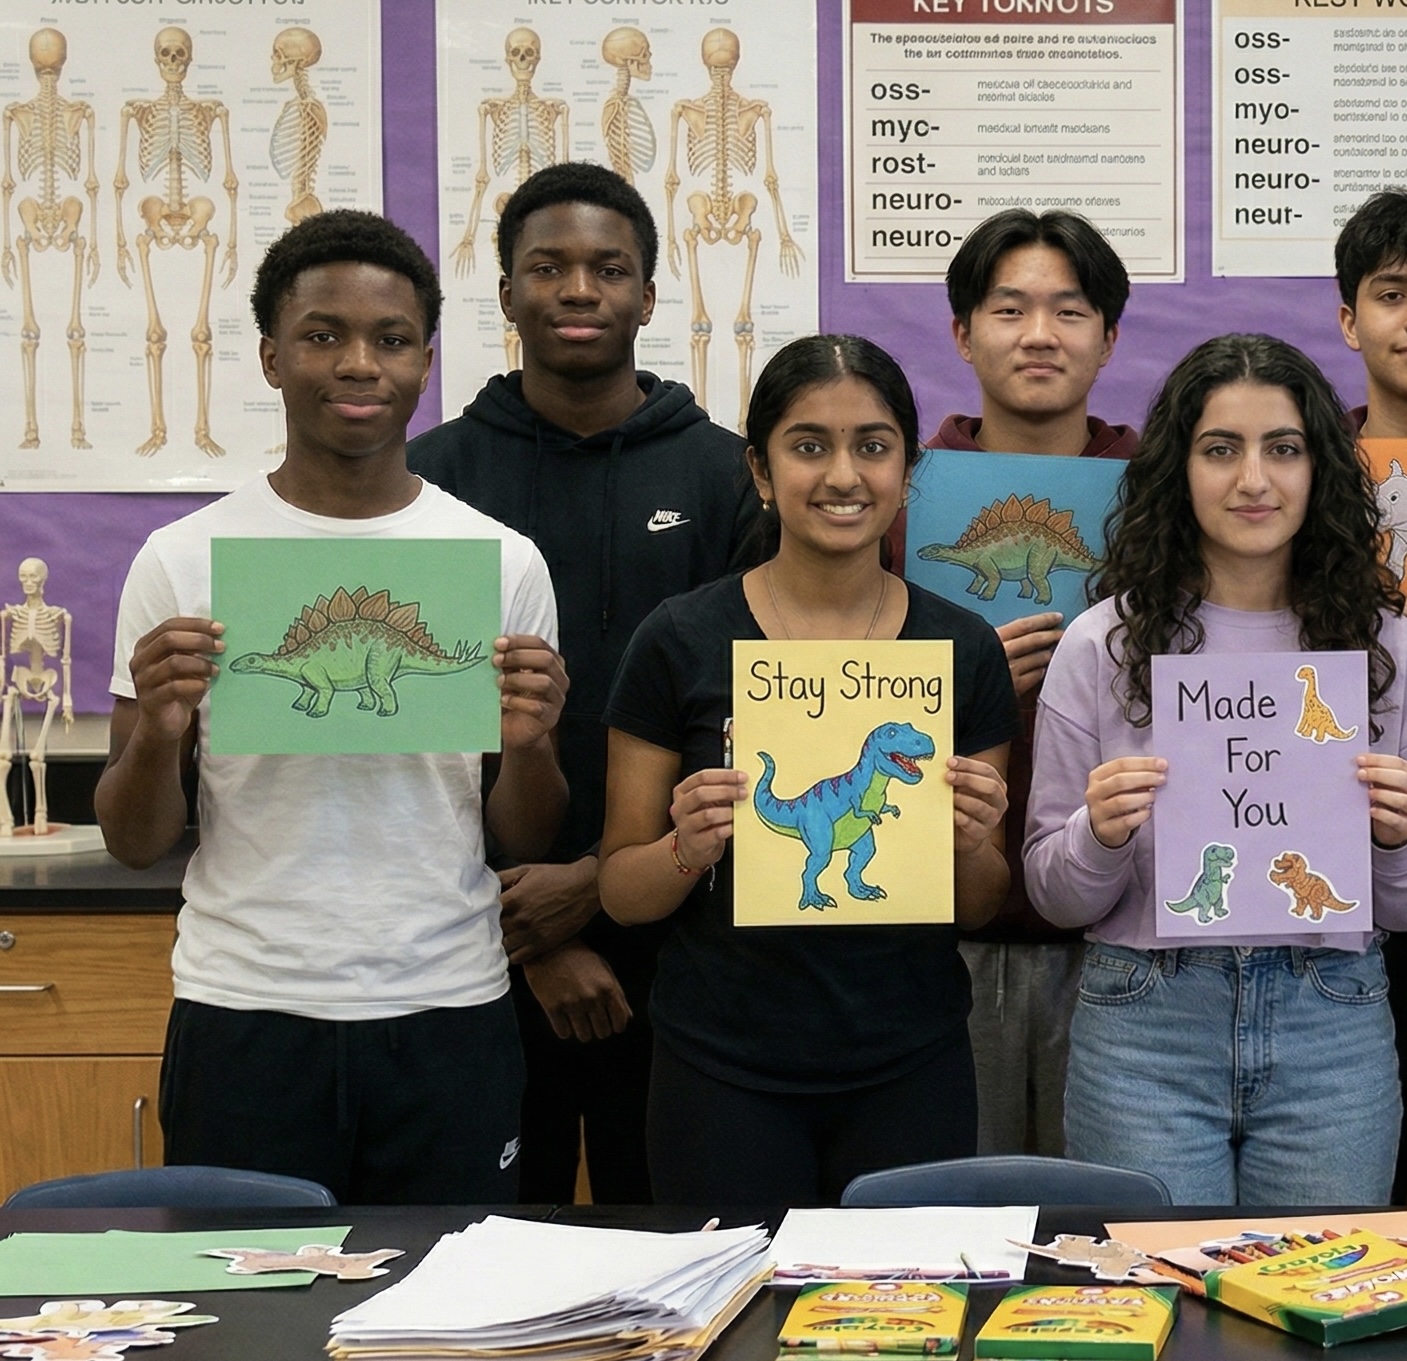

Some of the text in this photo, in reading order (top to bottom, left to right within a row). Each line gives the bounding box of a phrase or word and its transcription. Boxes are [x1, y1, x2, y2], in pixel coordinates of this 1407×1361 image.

[870, 33, 893, 44] The
[1235, 32, 1290, 49] oss-
[1235, 67, 1290, 84] oss-
[871, 83, 931, 100] oss-
[1235, 102, 1299, 125] myo-
[872, 119, 940, 143] myc-
[1235, 137, 1320, 154] neuro-
[872, 153, 936, 174] rost-
[1235, 173, 1320, 189] neuro-
[872, 193, 962, 210] neuro-
[872, 230, 963, 247] neuro-
[747, 660, 943, 719] Stay Strong
[1178, 680, 1277, 722] Made
[1226, 736, 1281, 773] For
[1222, 788, 1289, 829] You
